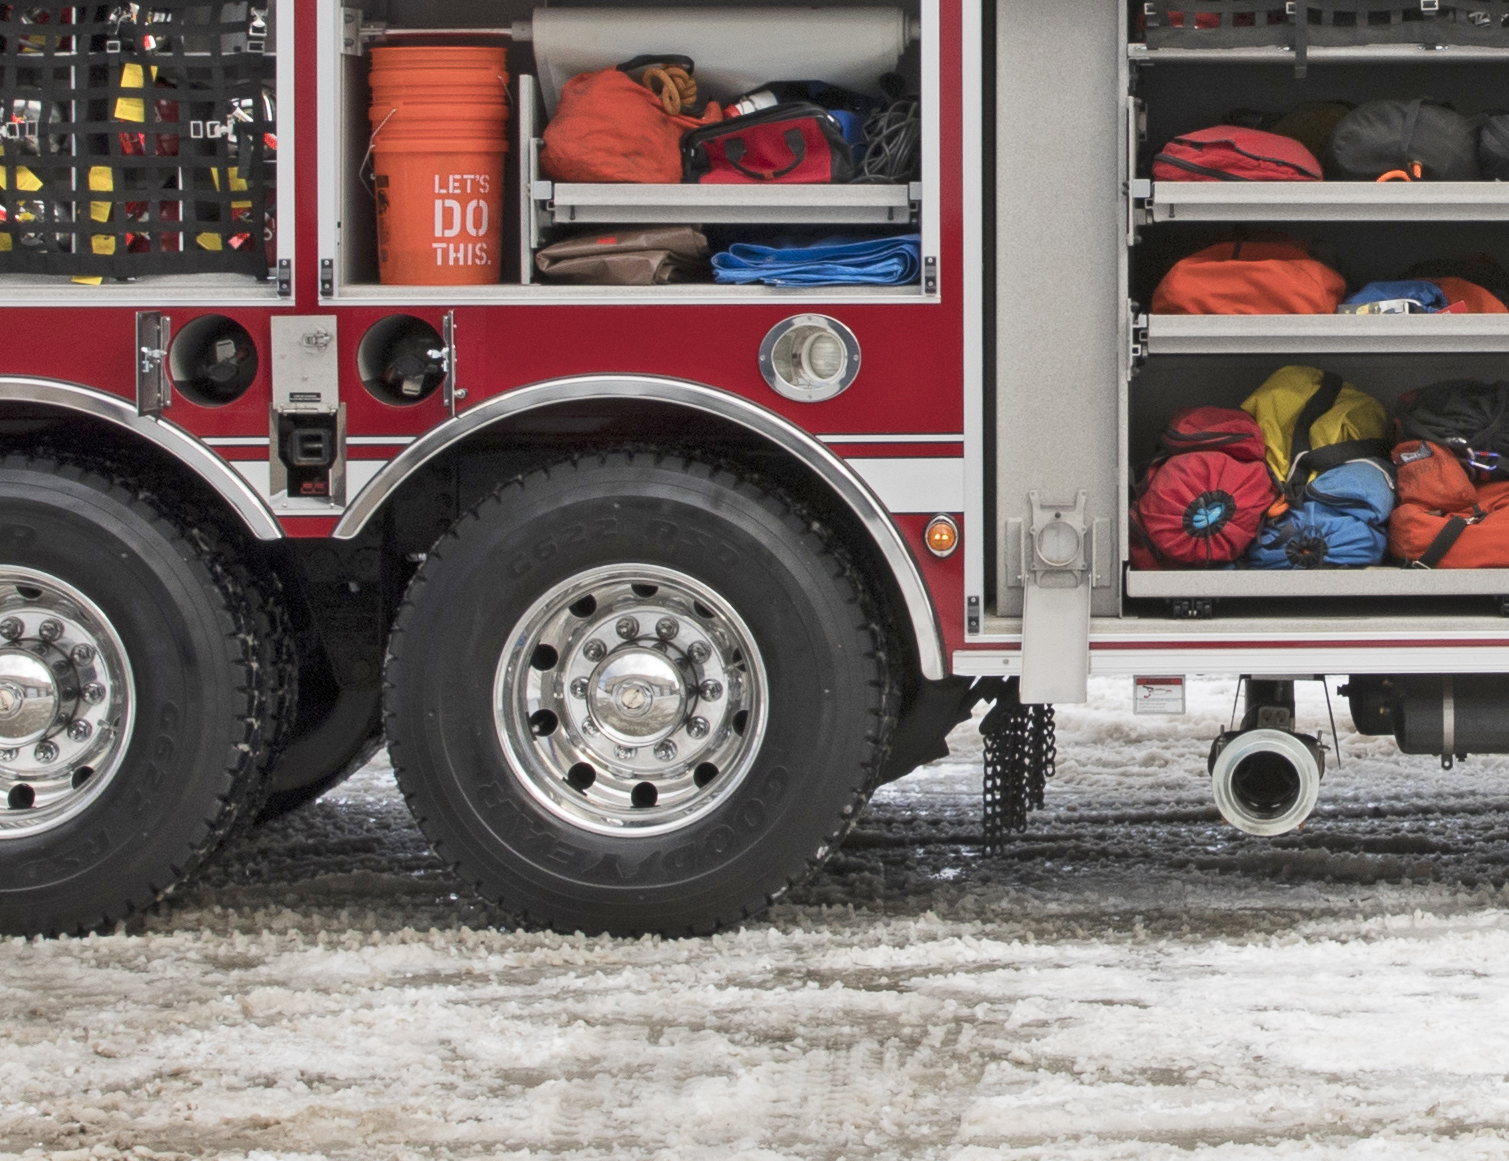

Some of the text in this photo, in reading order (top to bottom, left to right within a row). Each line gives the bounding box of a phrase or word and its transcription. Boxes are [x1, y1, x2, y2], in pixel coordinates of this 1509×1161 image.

[434, 174, 490, 194] LET'S
[434, 199, 489, 237] DO
[432, 242, 492, 266] THIS.
[507, 517, 618, 581] G622
[477, 764, 790, 884] GOODYEAR
